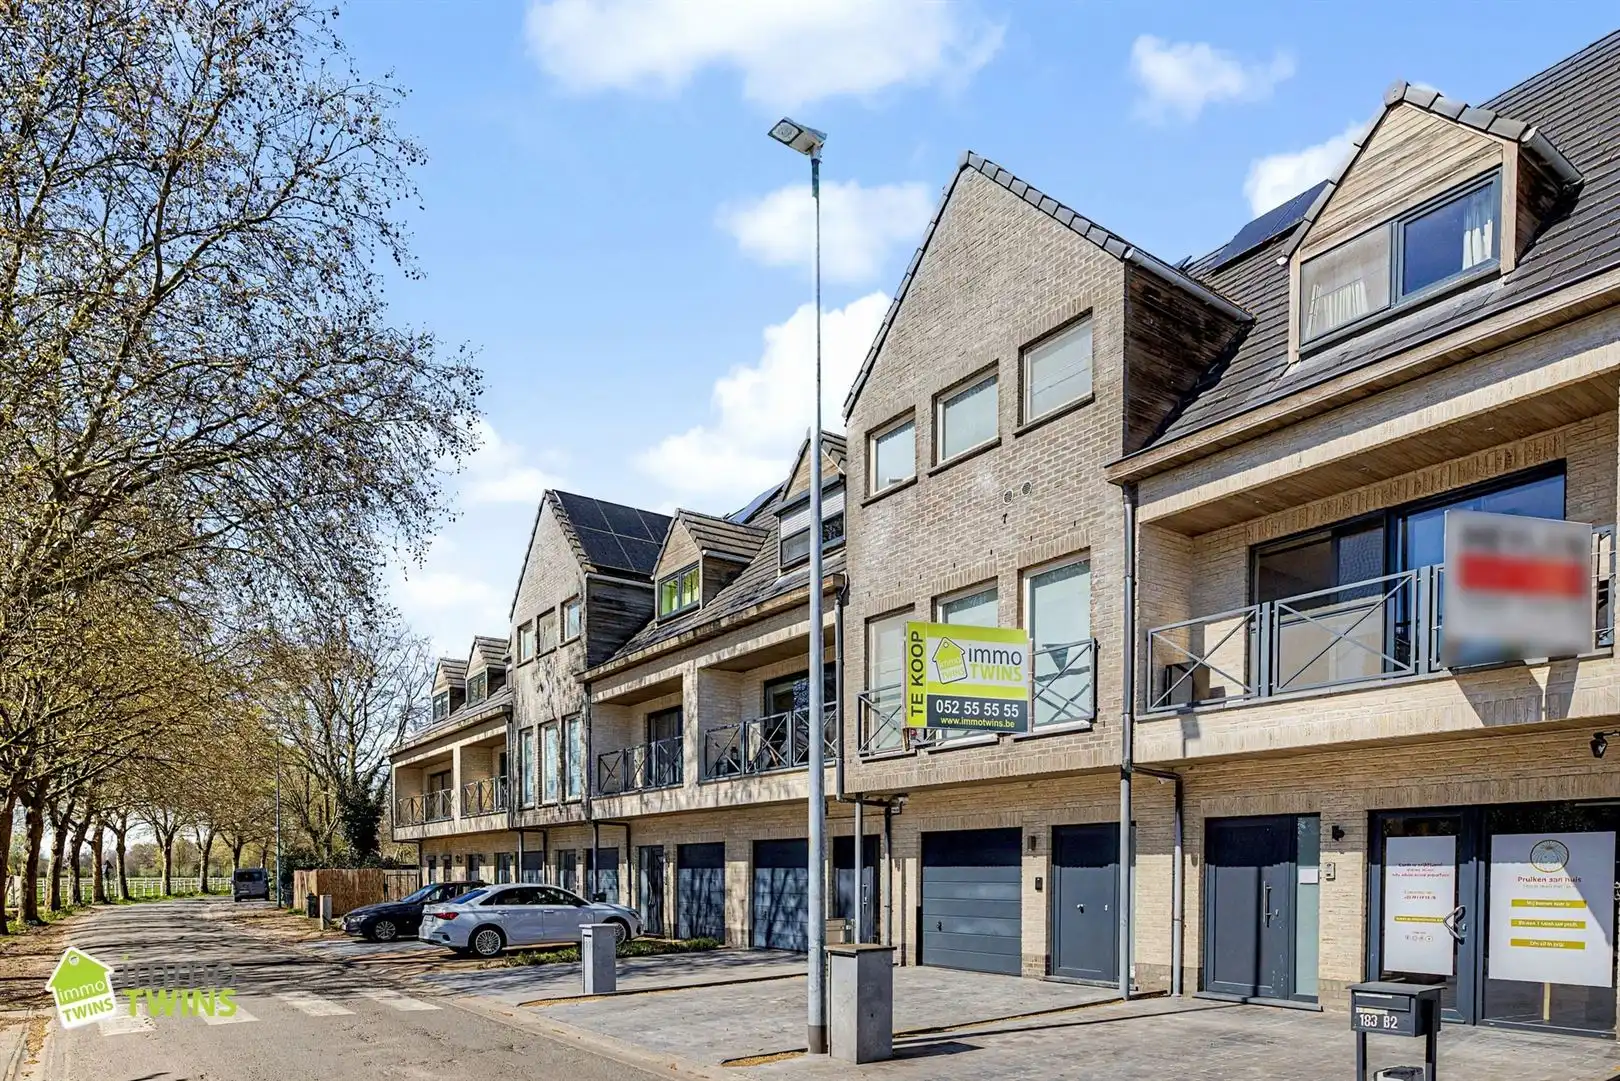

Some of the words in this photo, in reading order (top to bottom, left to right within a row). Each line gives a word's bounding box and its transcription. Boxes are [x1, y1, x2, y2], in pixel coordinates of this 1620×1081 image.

[911, 631, 923, 686] KOOP
[969, 644, 1022, 666] immo
[969, 664, 1023, 682] TWINS
[911, 693, 923, 717] TE
[936, 699, 959, 714] 052
[964, 701, 980, 715] 55
[984, 703, 1000, 716] 55
[1003, 704, 1019, 718] 55
[940, 716, 1015, 728] www.immotwins.be
[1360, 1013, 1378, 1027] 183
[1383, 1015, 1398, 1029] B2
